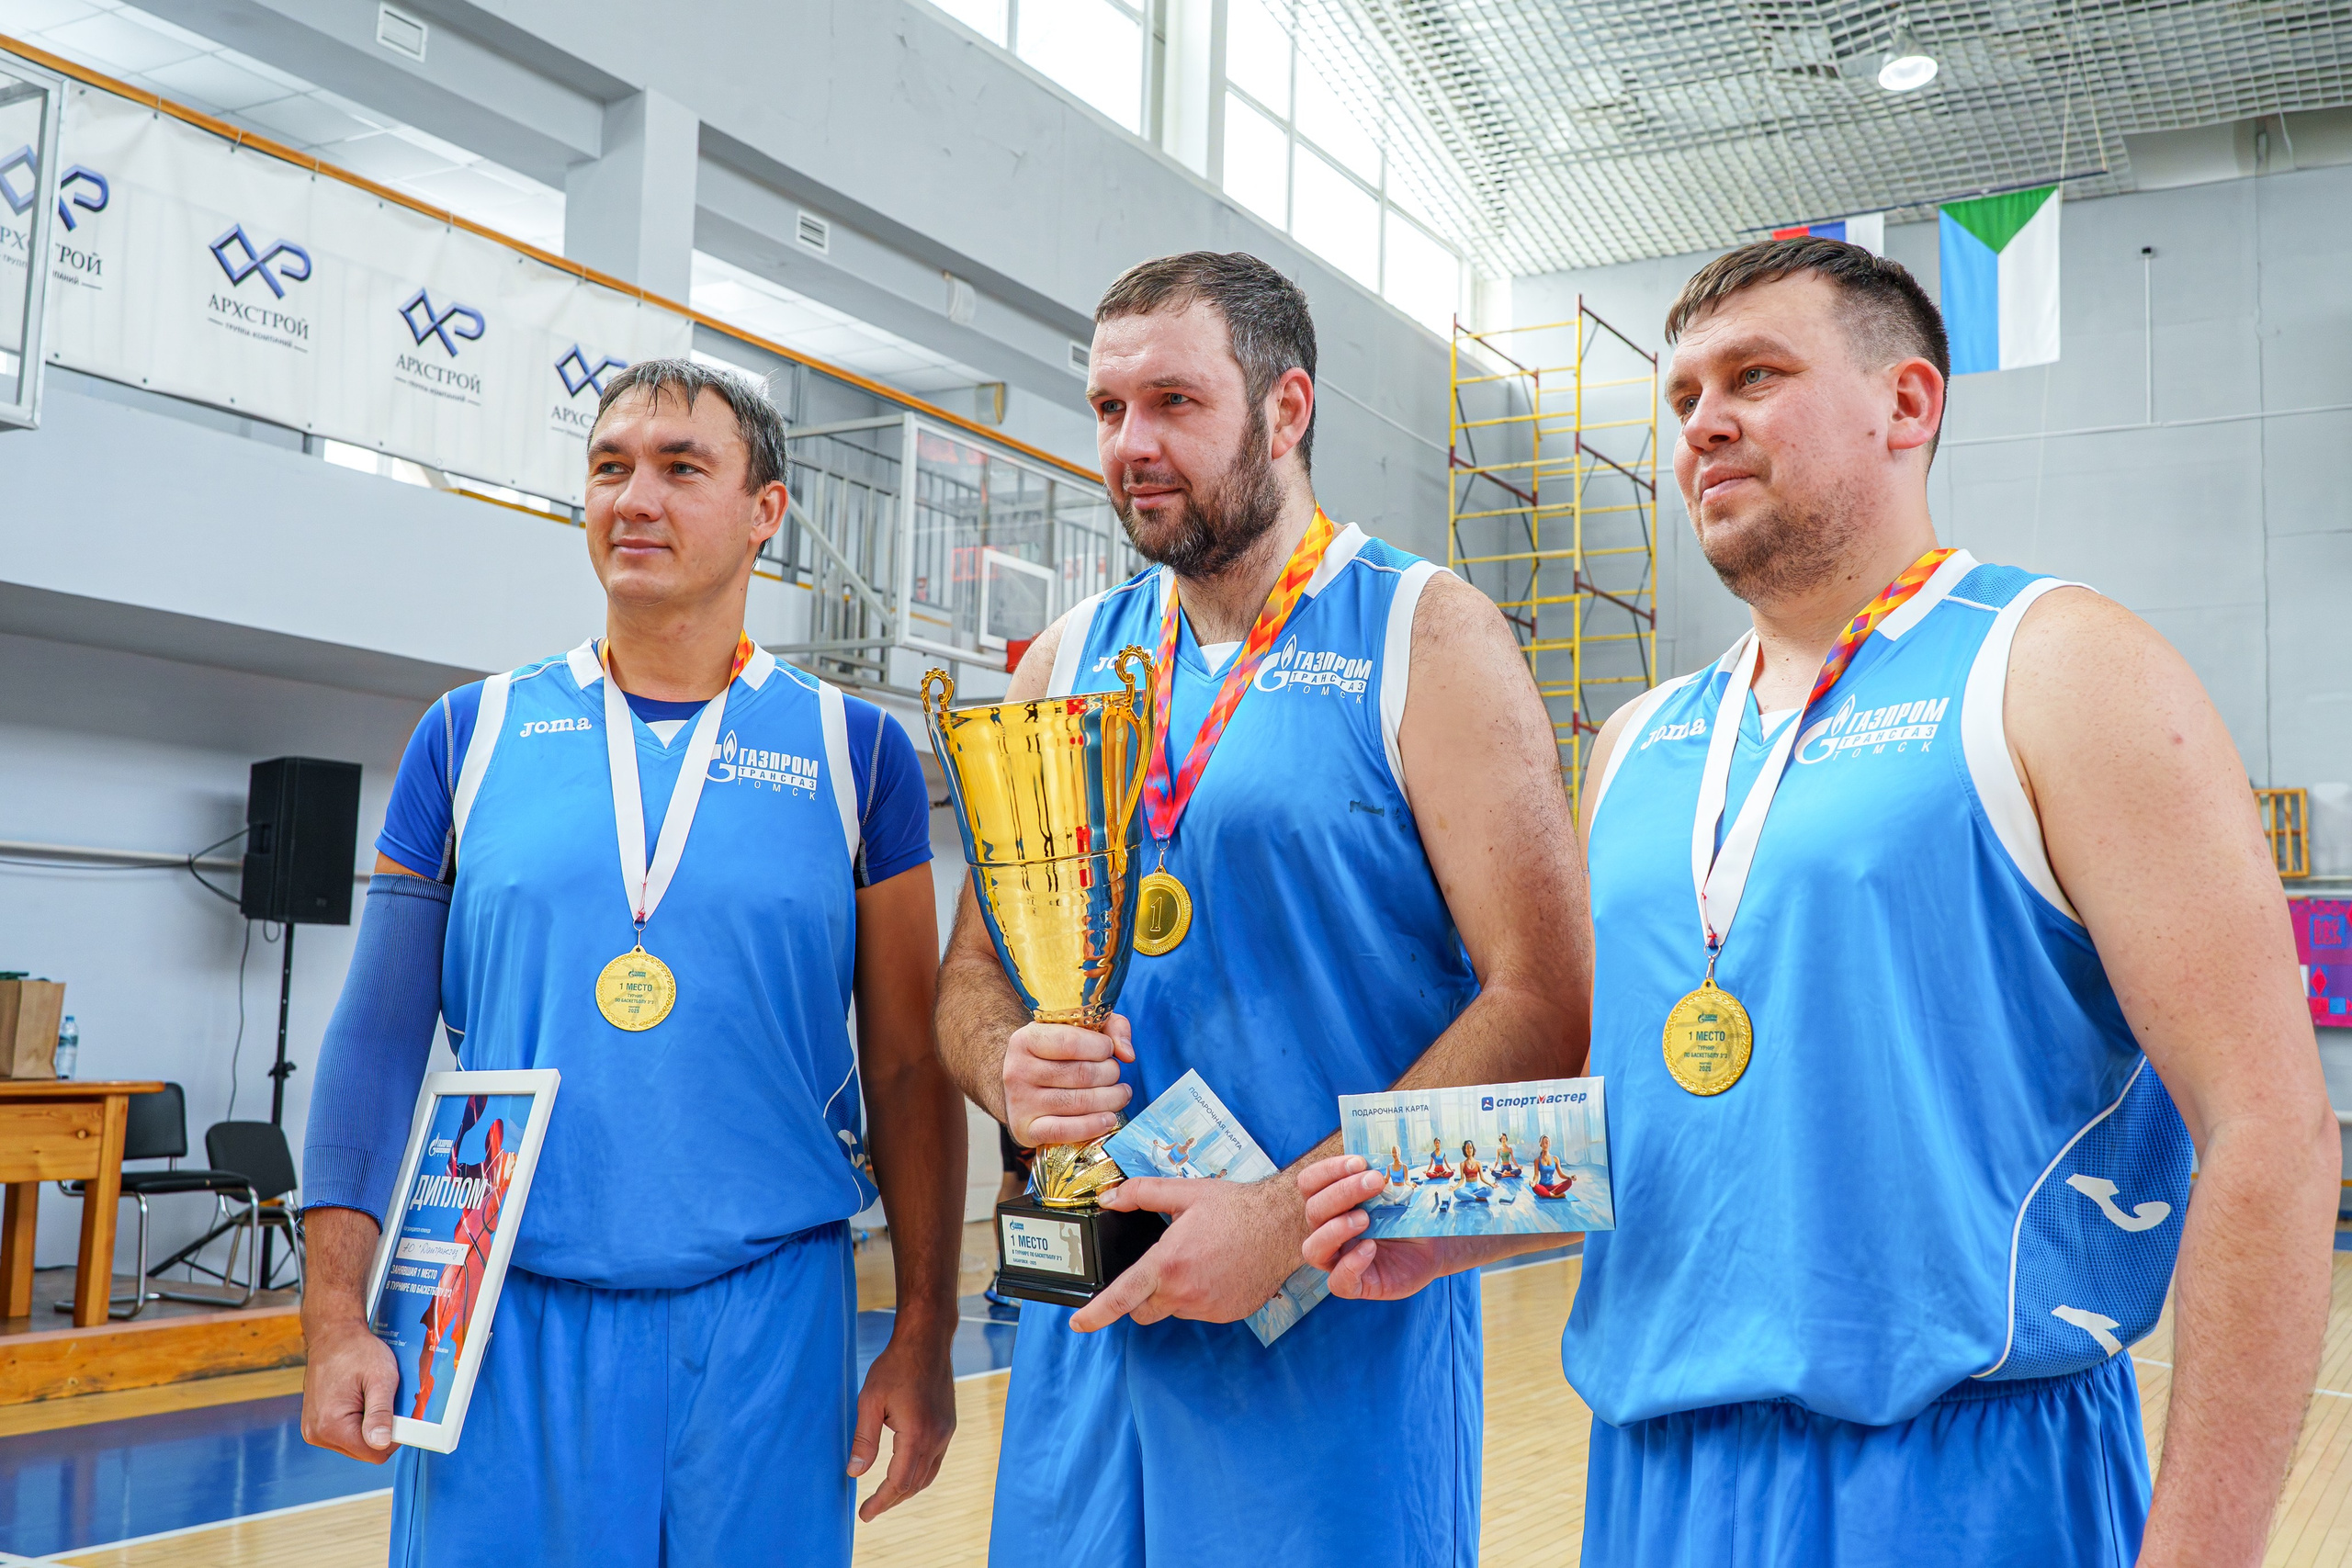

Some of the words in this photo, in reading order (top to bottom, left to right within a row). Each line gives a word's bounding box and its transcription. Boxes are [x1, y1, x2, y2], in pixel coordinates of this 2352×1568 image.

[209, 293, 310, 340] АРХСТРОЙ
[396, 354, 481, 394] АРХСТРОЙ
[1293, 650, 1374, 681] ГАЗПРОМ
[1291, 672, 1365, 692] ТРАНСГАЗ
[1287, 683, 1363, 705] ТОМСК
[1845, 697, 1951, 735] ГАЗПРОМ
[1842, 726, 1935, 747] ТРАНСГАЗ
[1833, 740, 1933, 761] ТОМСК
[738, 747, 819, 779] ГАЗПРОМ
[737, 777, 816, 801] ТОМСК
[739, 767, 816, 790] ТРАНСГАЗ
[1149, 897, 1162, 932] 1
[627, 983, 653, 992] МЕСТО
[1689, 1031, 1692, 1041] 1
[1696, 1031, 1725, 1042] МЕСТО
[1351, 1106, 1404, 1117] ПОДАРОЧНАЯ
[1405, 1104, 1430, 1113] КАРТА
[1496, 1092, 1588, 1109] спортмастер
[1189, 1087, 1227, 1131] ПОДАРОЧНАЯ
[1225, 1129, 1243, 1151] КАРТА
[409, 1174, 489, 1212] ДИПЛОМ
[1011, 1234, 1015, 1247] 1
[1018, 1235, 1048, 1250] МЕСТО
[421, 1268, 438, 1280] МЕСТО
[390, 1280, 411, 1292] ТУРНИРЕ
